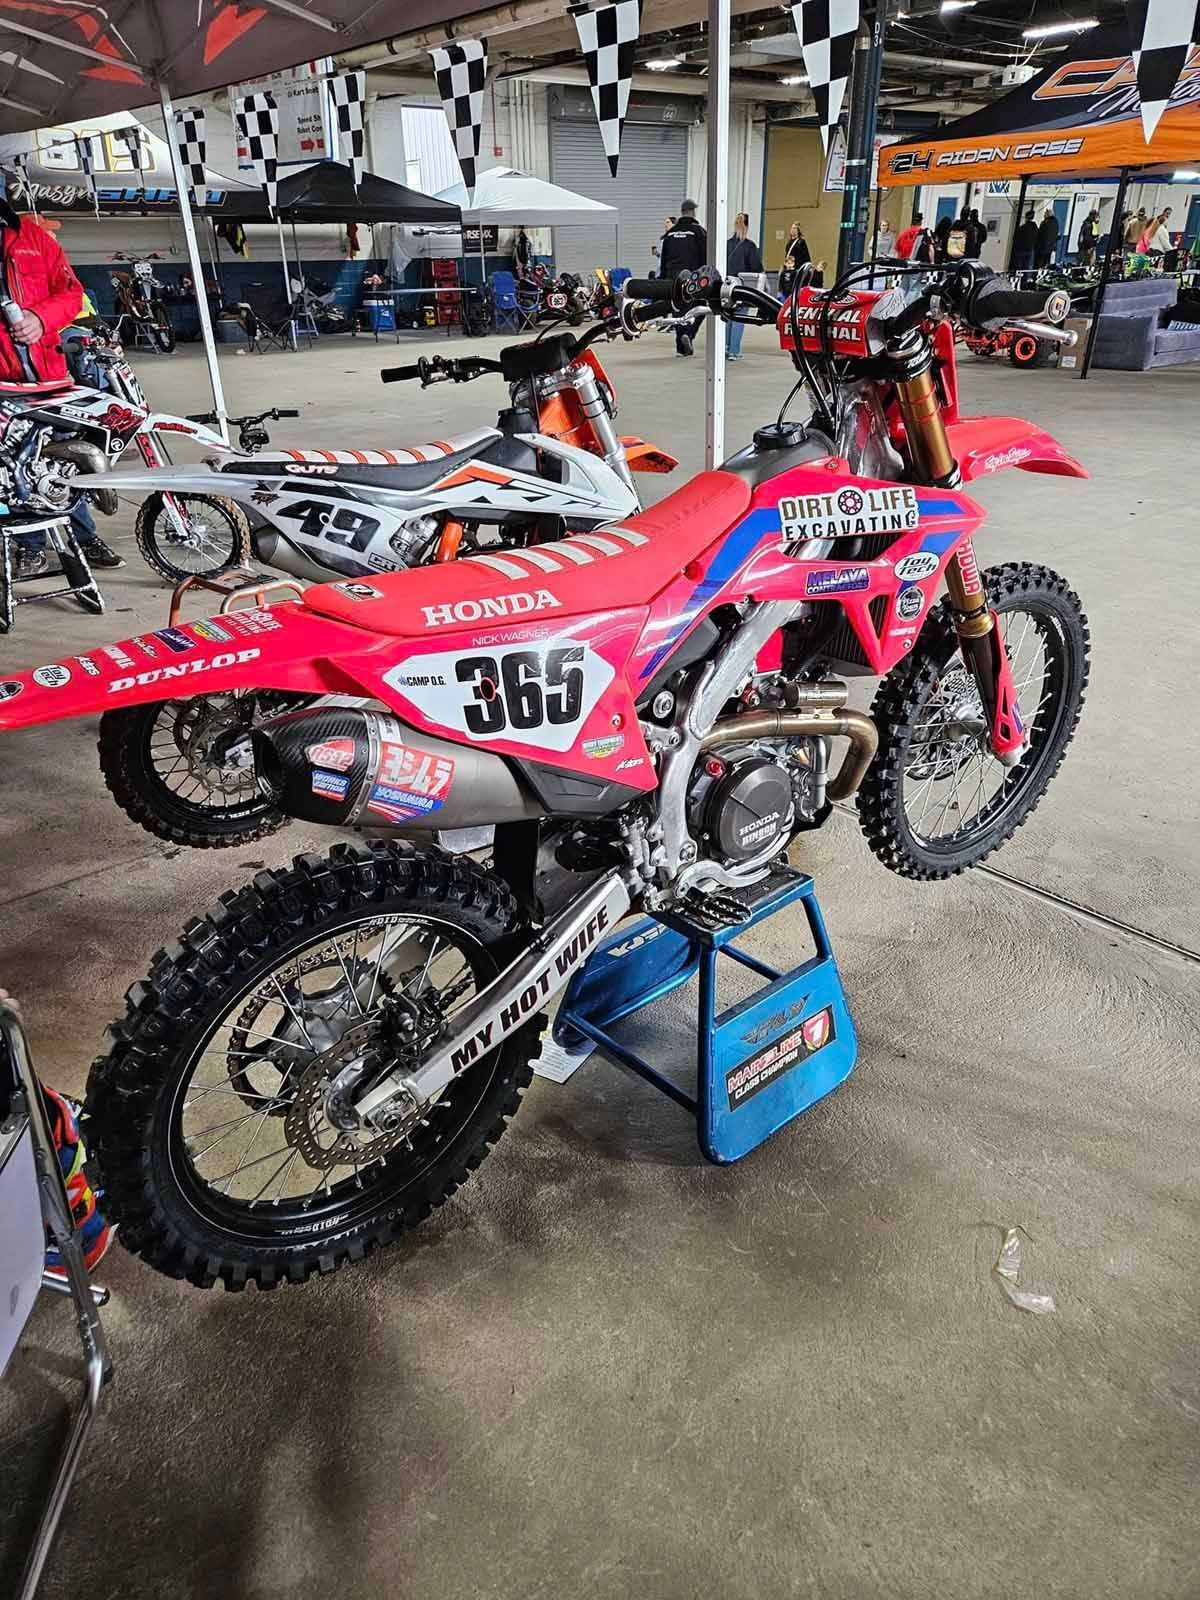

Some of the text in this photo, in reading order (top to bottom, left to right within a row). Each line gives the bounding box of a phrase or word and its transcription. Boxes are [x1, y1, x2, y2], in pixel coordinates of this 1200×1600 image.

[936, 146, 1011, 167] AIDAN
[1013, 138, 1085, 160] CASE
[784, 322, 862, 340] RENHAL
[285, 464, 339, 475] GUTS
[781, 489, 916, 521] DIRT LIFE
[276, 500, 382, 553] 49
[785, 510, 917, 540] EXCAVATING
[903, 556, 933, 567] Toy
[808, 567, 868, 586] MELAVA
[421, 589, 562, 627] HONDA
[472, 629, 550, 647] NICK WAGNER
[107, 648, 262, 693] DUNLOP
[406, 675, 447, 687] CAMP O.G.
[455, 646, 586, 734] 365
[739, 811, 780, 836] HONDA
[450, 1021, 494, 1074] MY
[499, 967, 550, 1033] HOT
[554, 904, 609, 977] WIFE
[735, 1074, 760, 1100] CLASS
